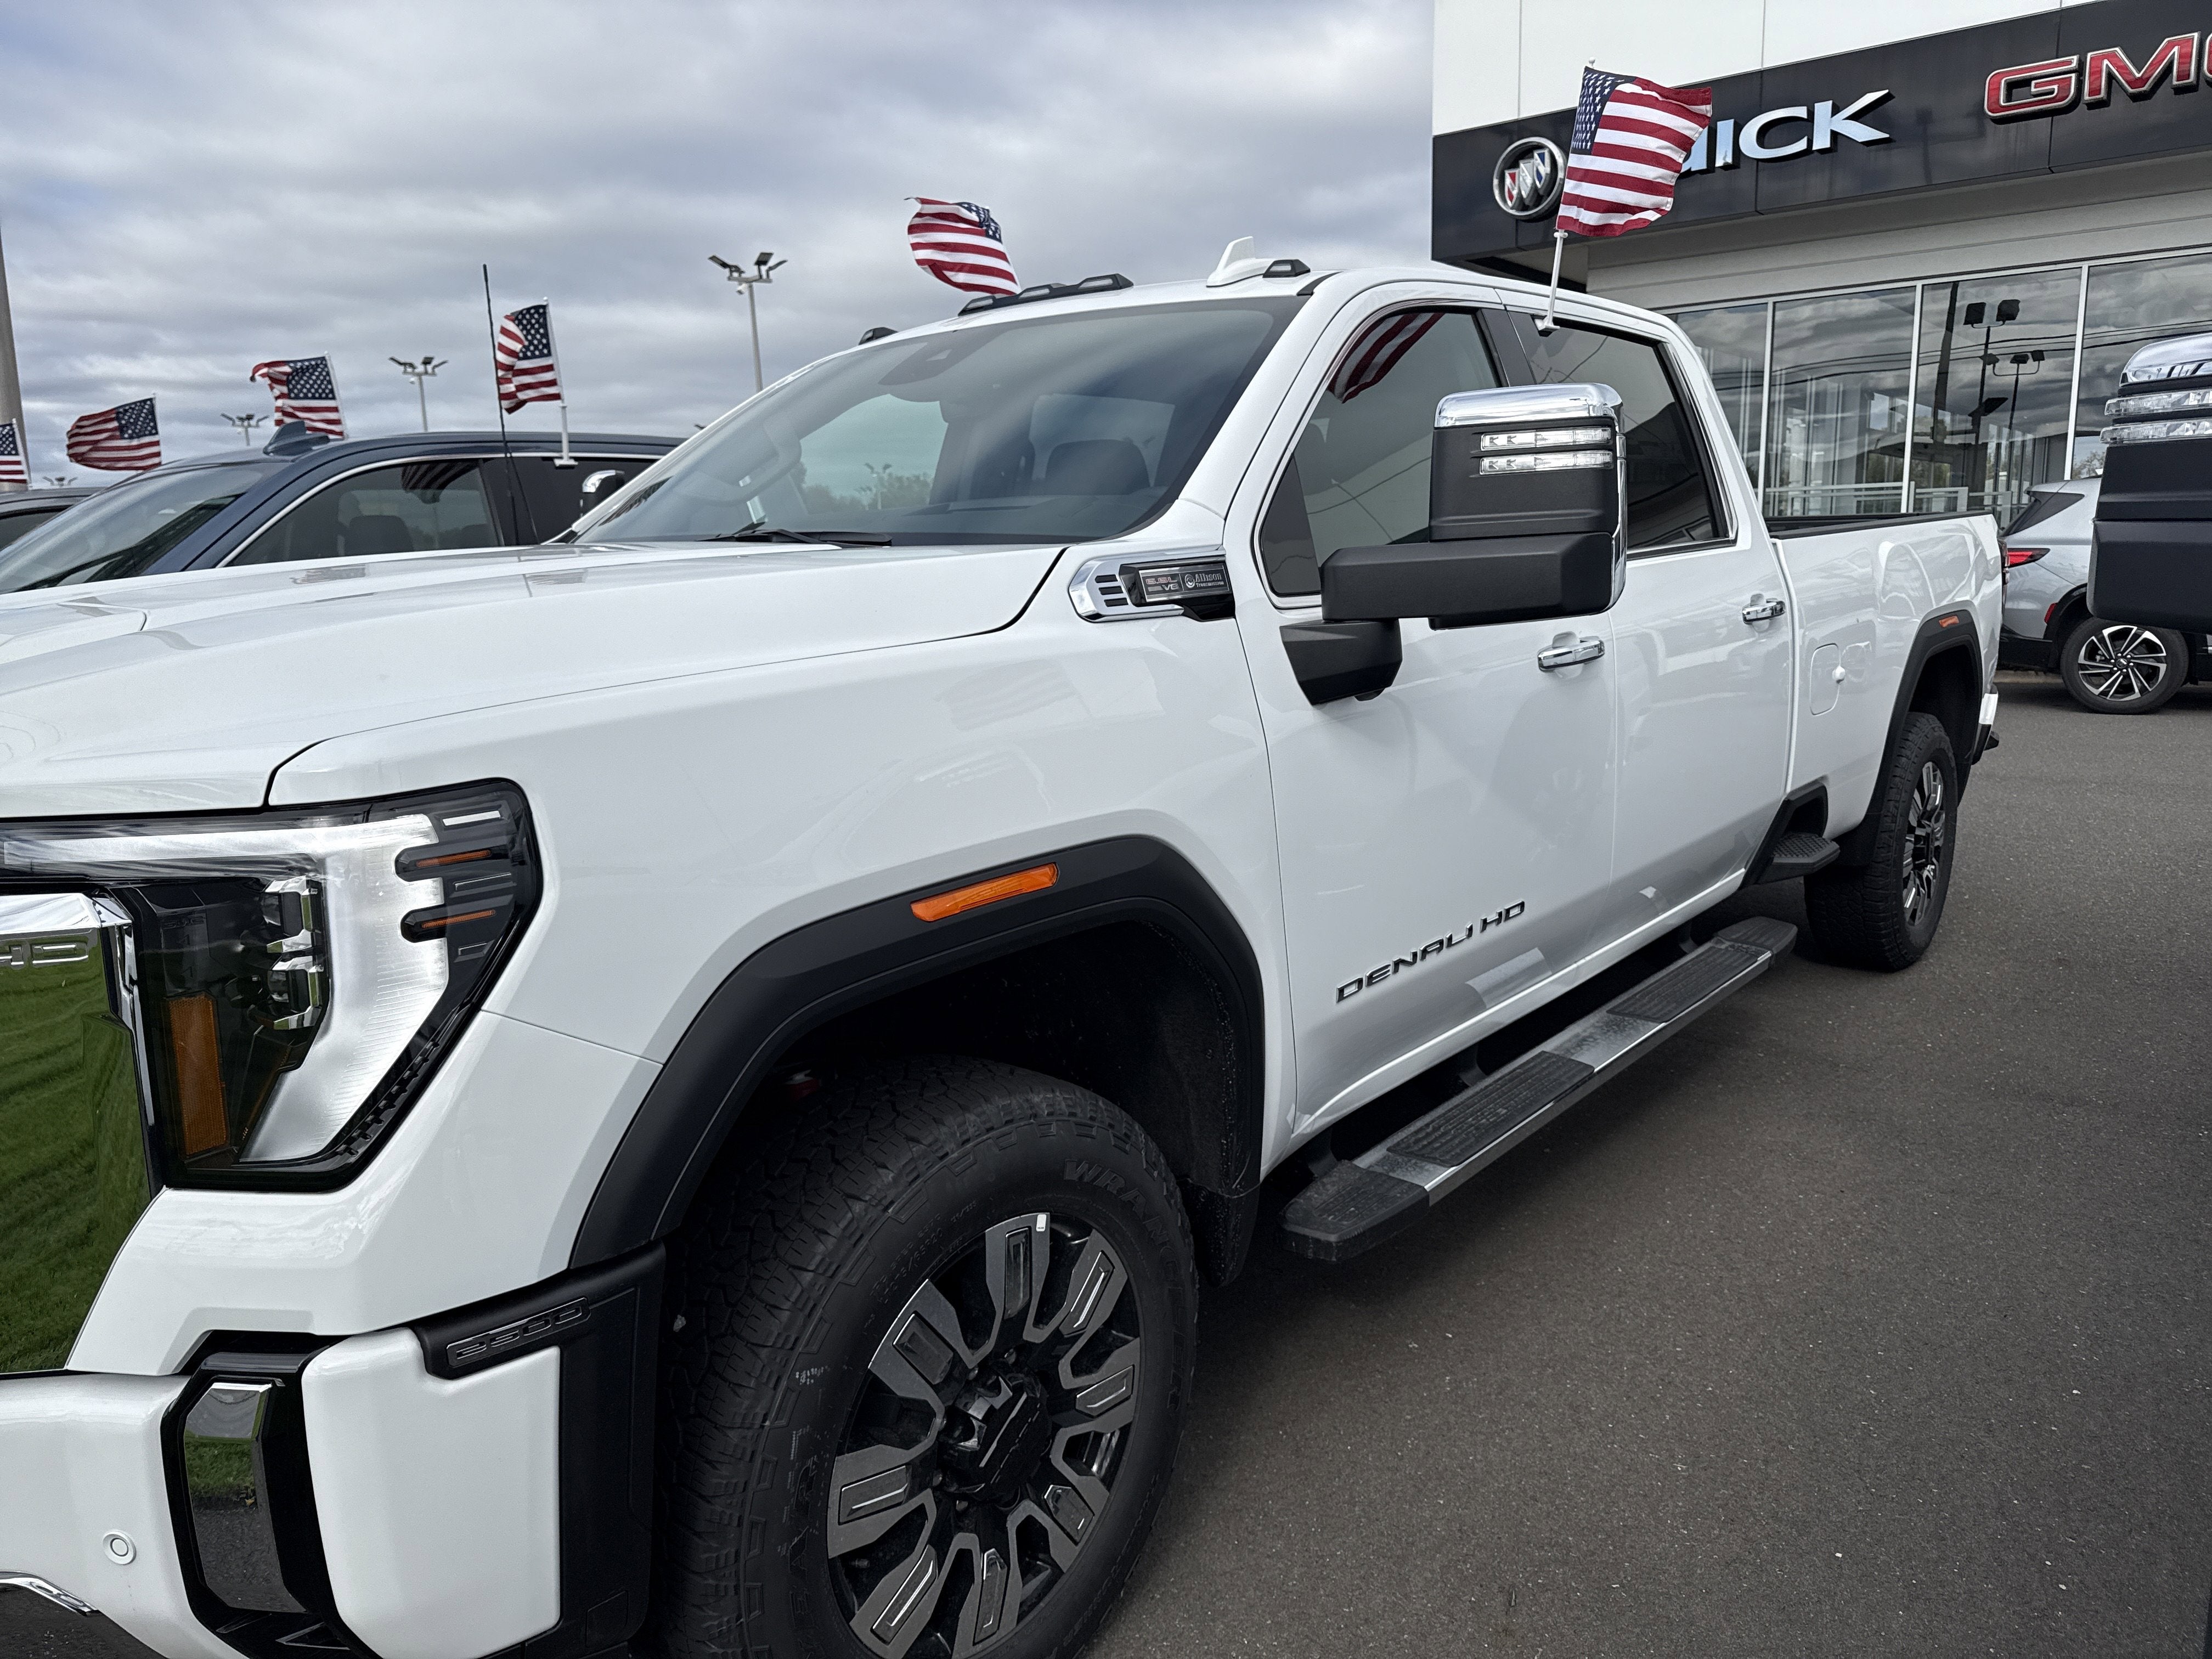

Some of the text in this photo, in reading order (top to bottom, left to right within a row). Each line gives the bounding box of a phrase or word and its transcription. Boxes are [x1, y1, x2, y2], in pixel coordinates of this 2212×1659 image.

[1984, 31, 2212, 119] GM
[1680, 89, 1890, 173] ICK
[1146, 577, 1177, 585] 6.6L
[1195, 573, 1222, 583] Allison
[1336, 900, 1526, 1004] DENALI HD
[1064, 1159, 1186, 1410] WRANGLER
[456, 1306, 583, 1359] 2500
